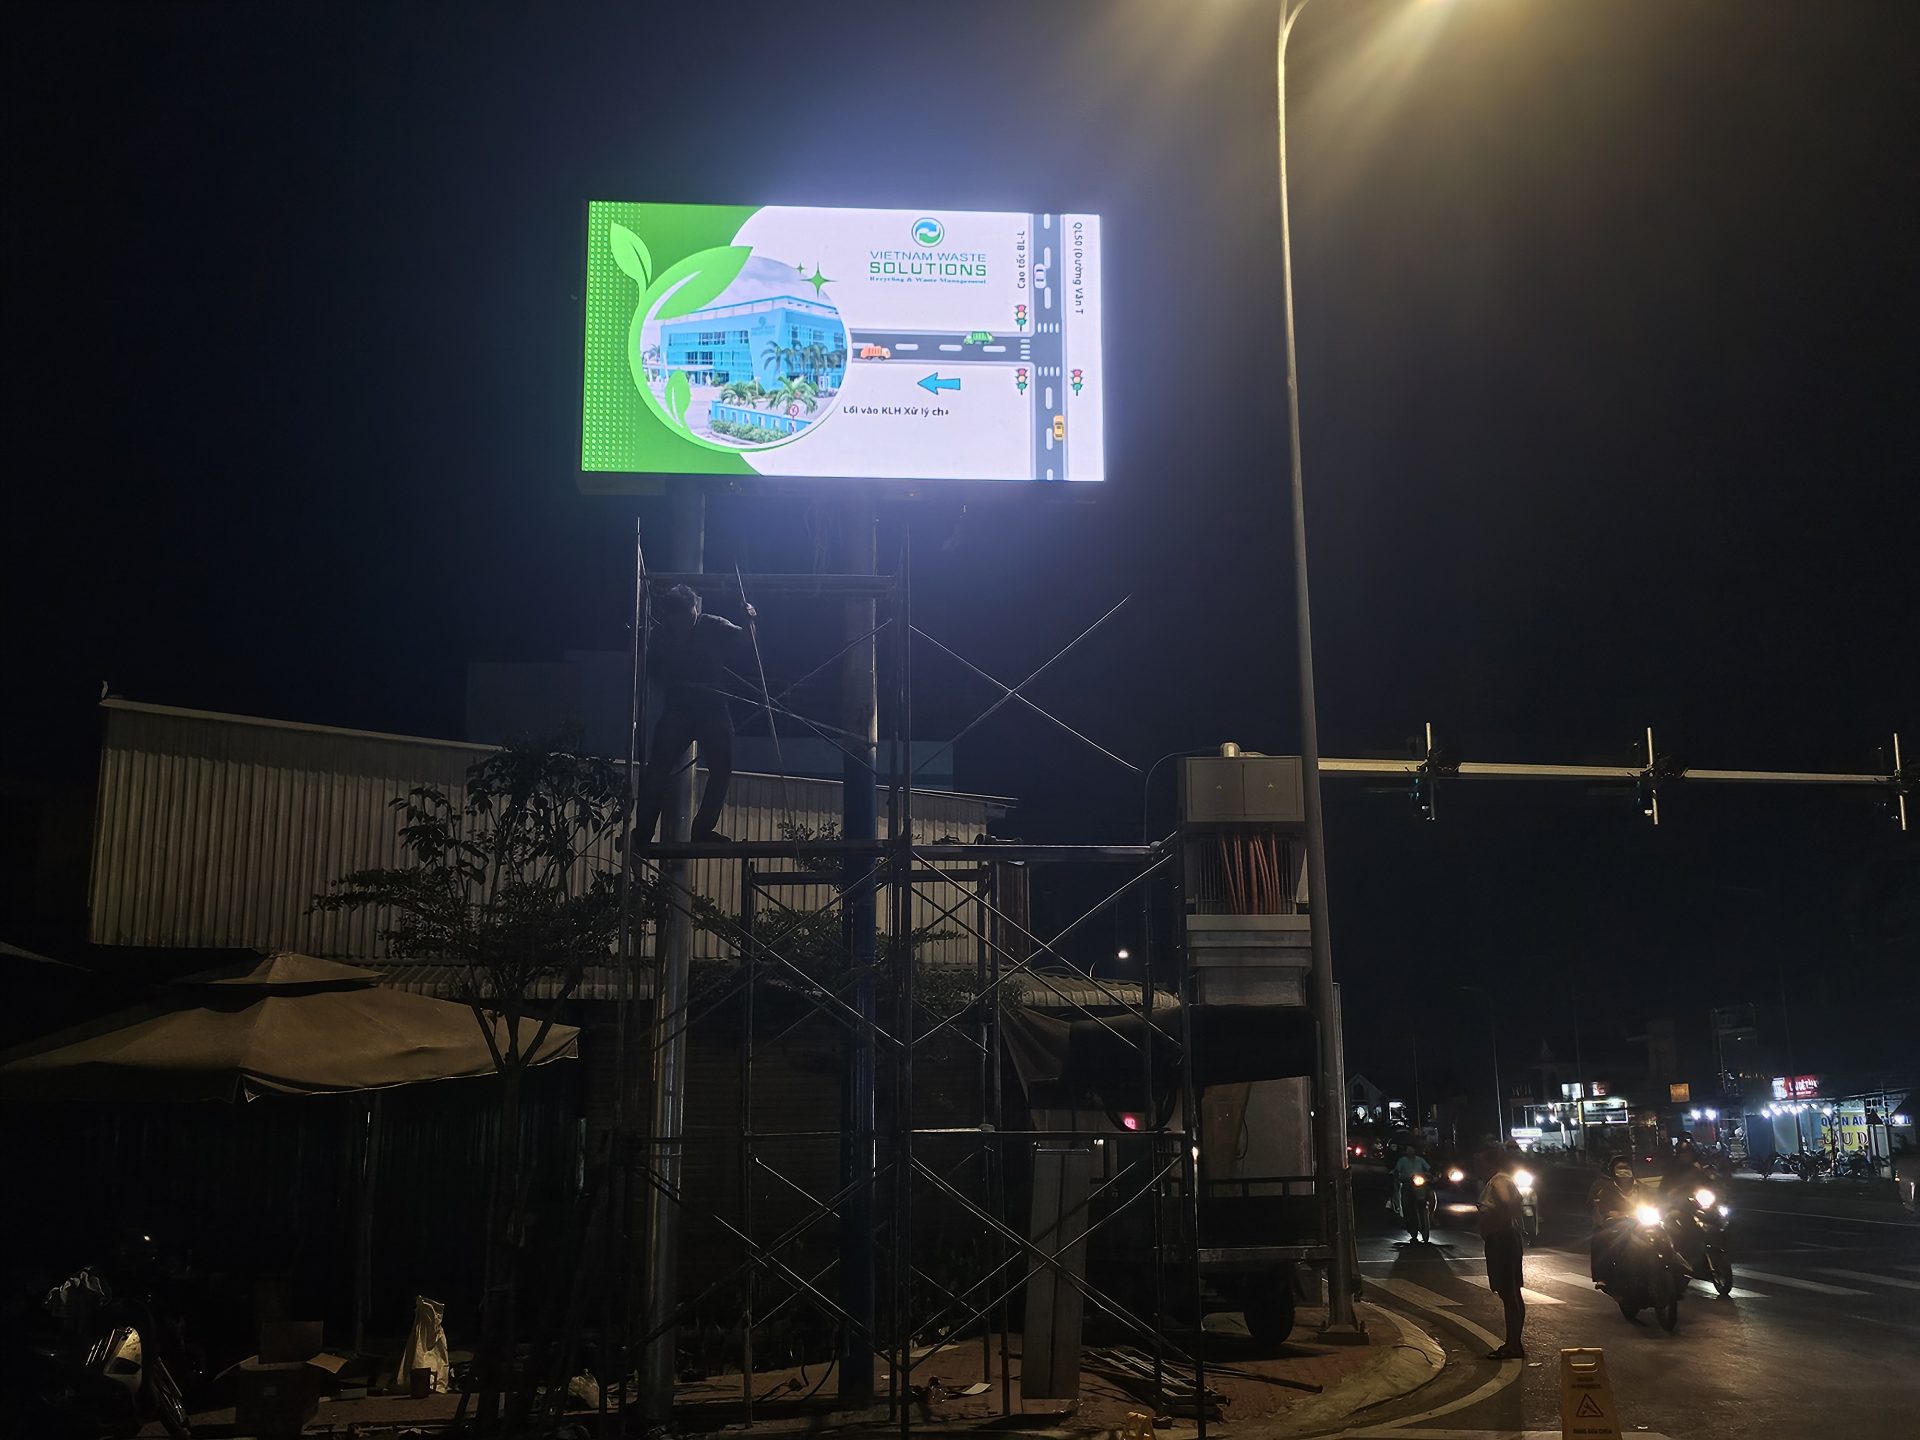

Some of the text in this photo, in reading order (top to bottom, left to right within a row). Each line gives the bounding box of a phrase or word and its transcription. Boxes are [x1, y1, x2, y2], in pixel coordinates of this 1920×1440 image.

[1073, 222, 1083, 246] QL50
[870, 251, 987, 262] VIETNAM WASTE
[870, 262, 987, 276] SOLUTIONS
[1017, 272, 1025, 289] Cao
[881, 407, 901, 415] KLH
